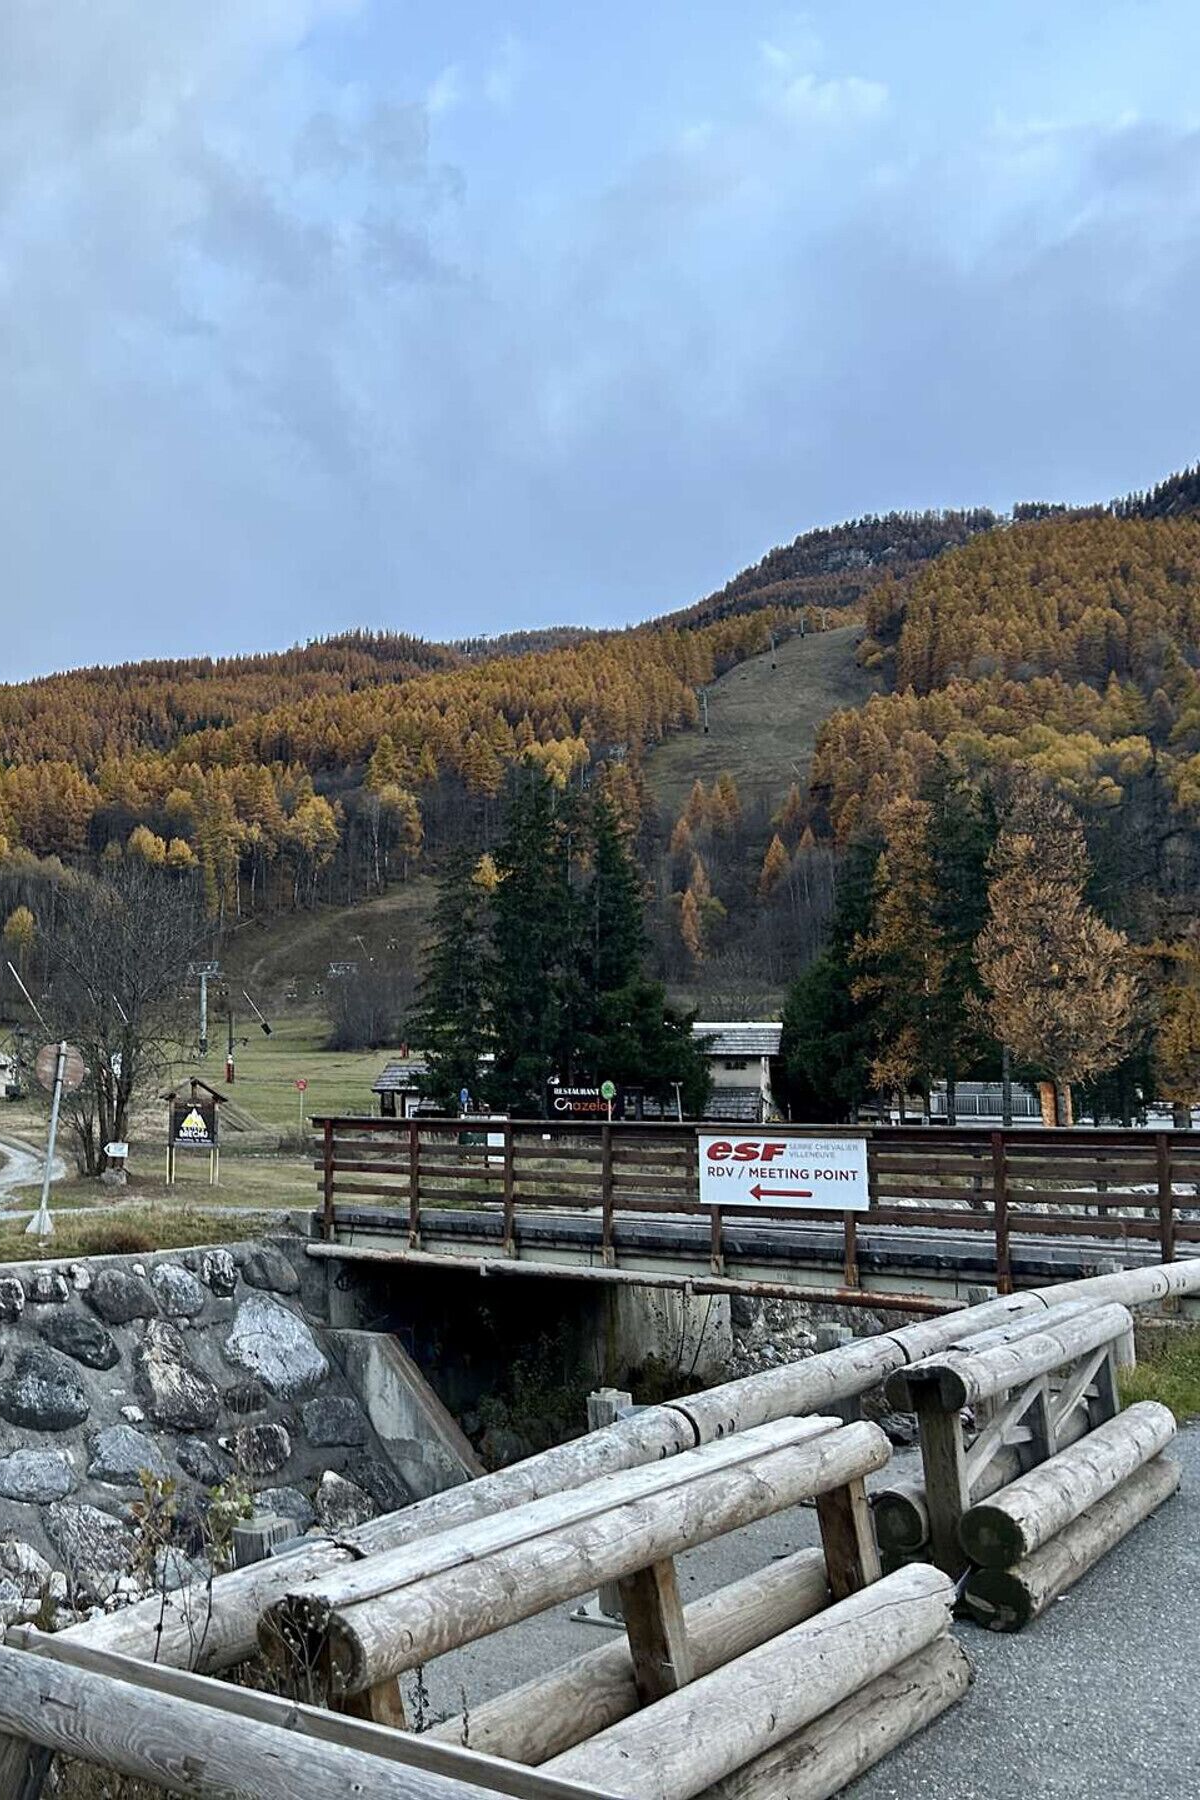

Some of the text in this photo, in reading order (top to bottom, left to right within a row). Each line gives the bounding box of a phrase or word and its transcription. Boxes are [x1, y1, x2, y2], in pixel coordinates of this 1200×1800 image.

[554, 1087, 600, 1095] RESTAURANT
[815, 1143, 858, 1152] CHEVALIER
[789, 1151, 835, 1159] VILLENEUVE
[707, 1166, 859, 1182] RDV / MEETING POINT
